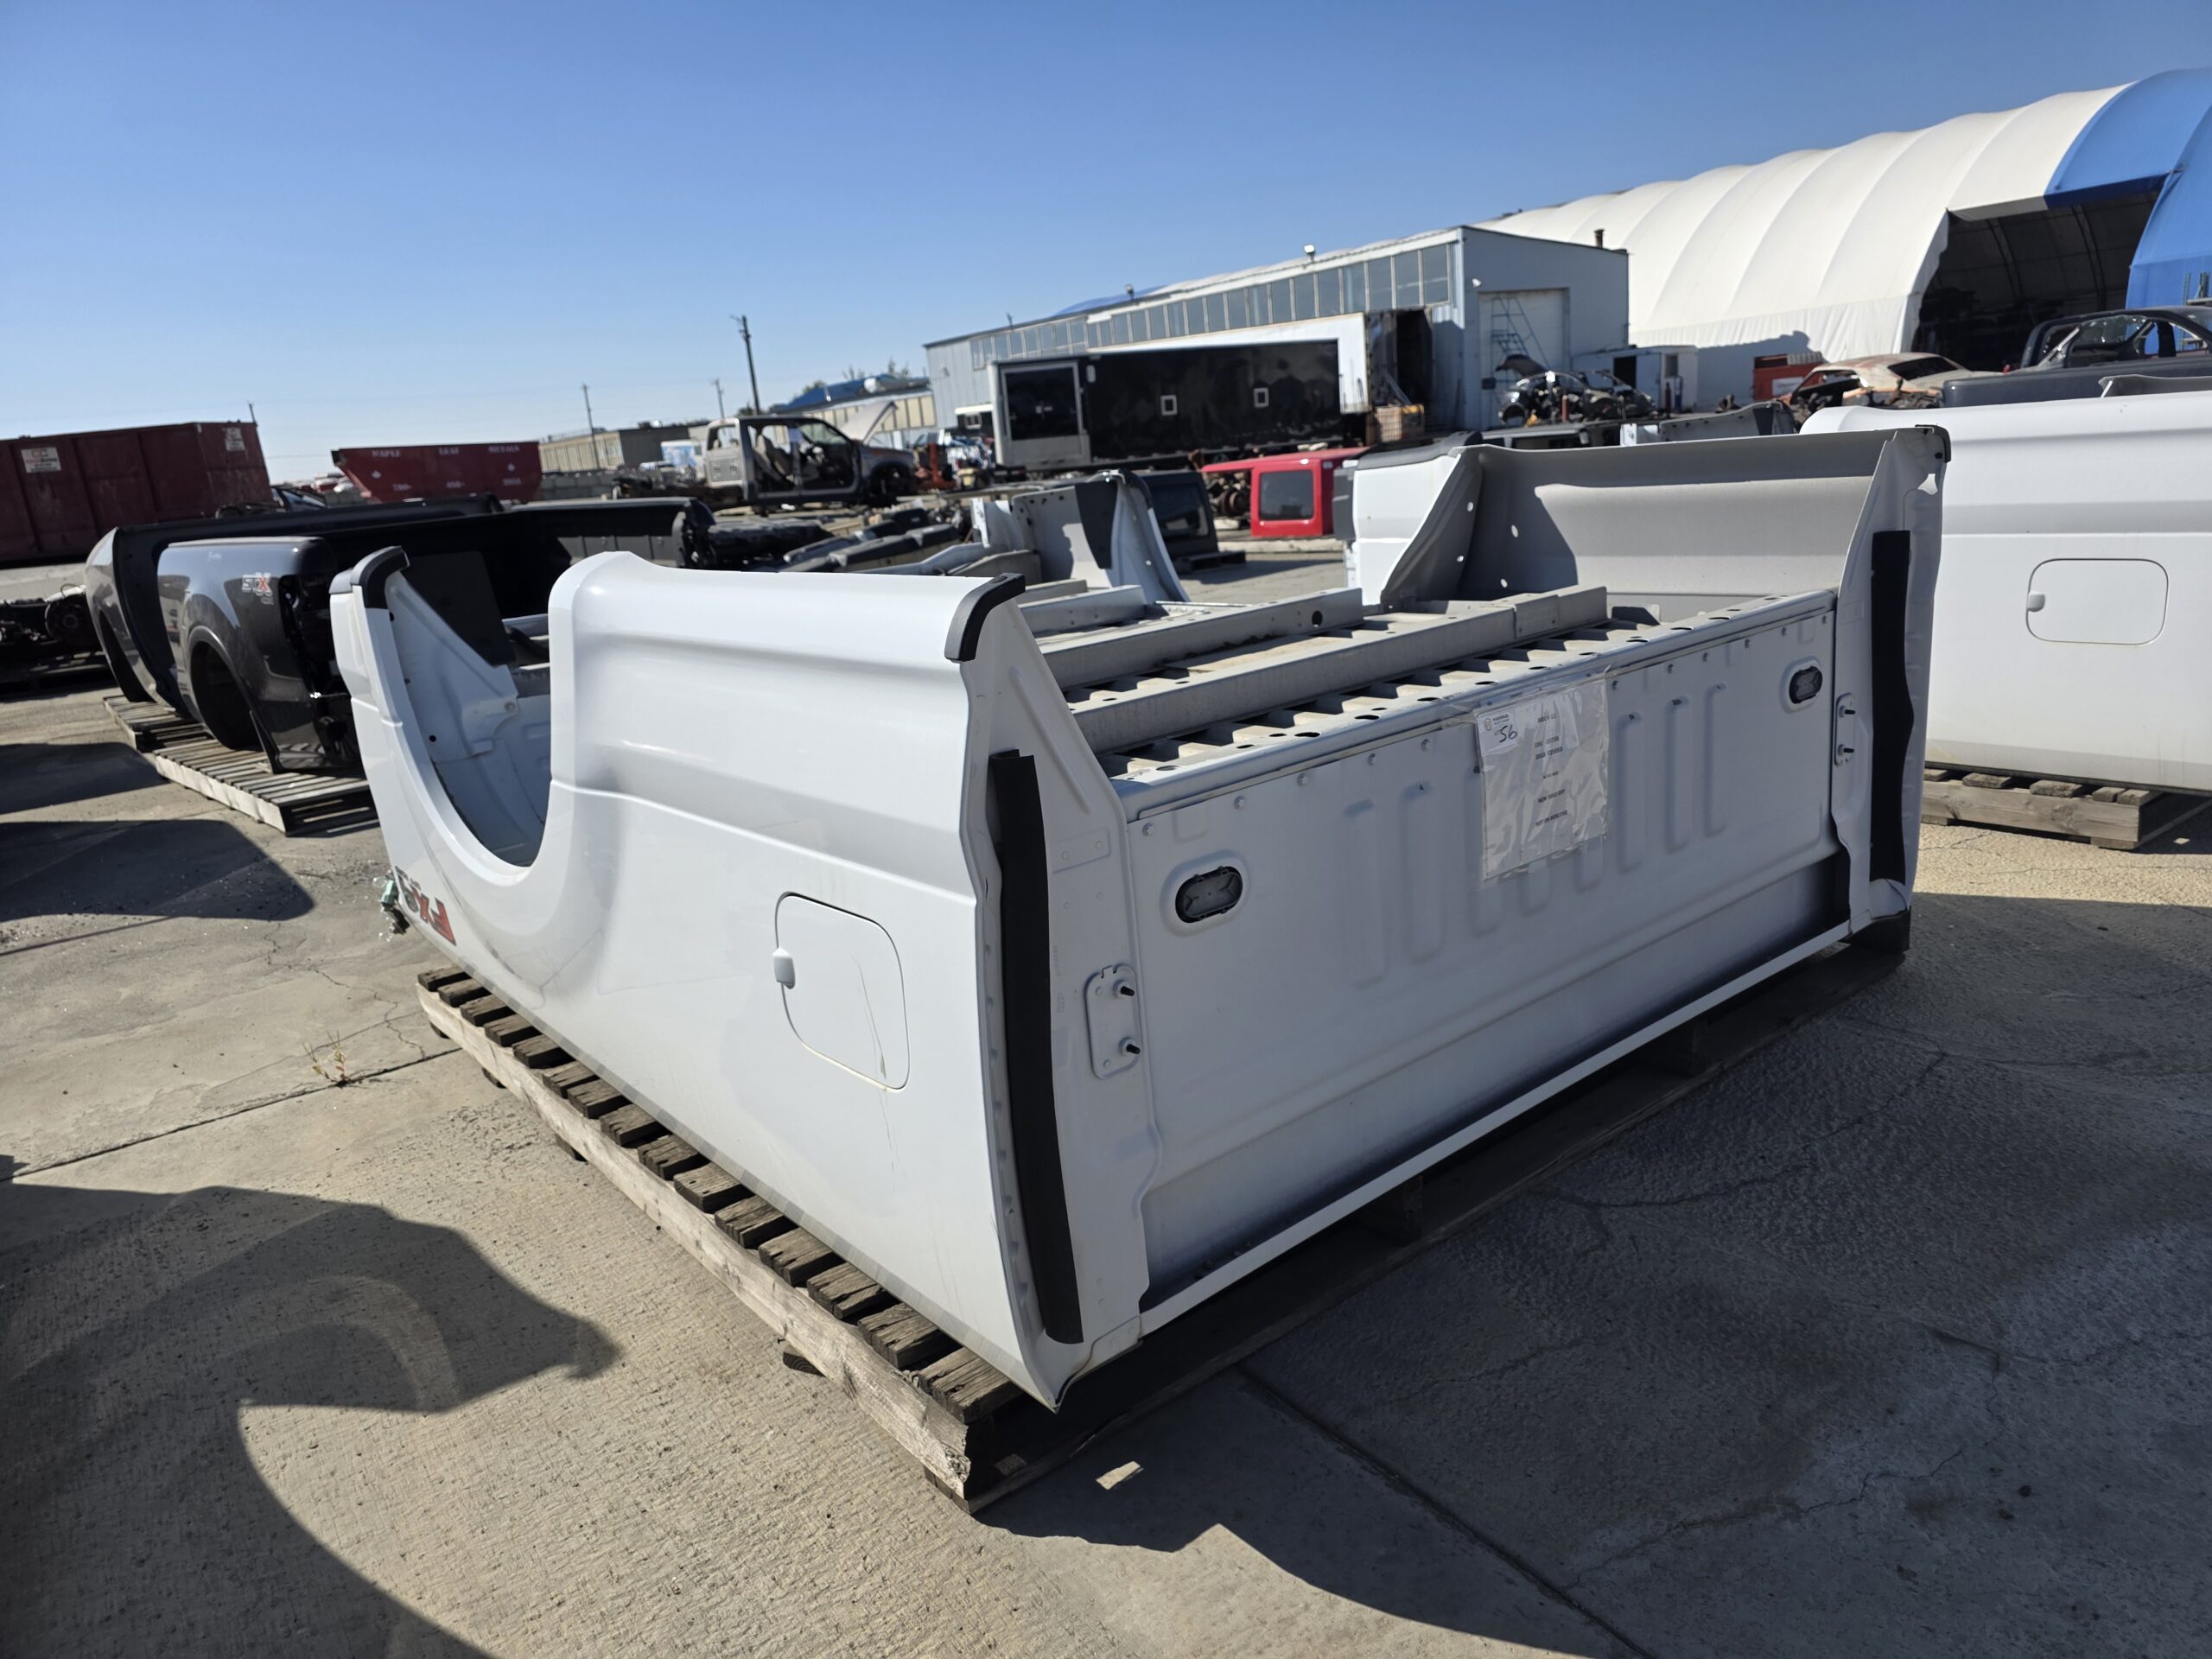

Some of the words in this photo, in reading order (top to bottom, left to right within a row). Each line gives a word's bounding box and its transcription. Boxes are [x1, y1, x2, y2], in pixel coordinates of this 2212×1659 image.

[242, 572, 272, 596] STX
[1499, 724, 1518, 742] 56
[397, 873, 457, 947] FX4
